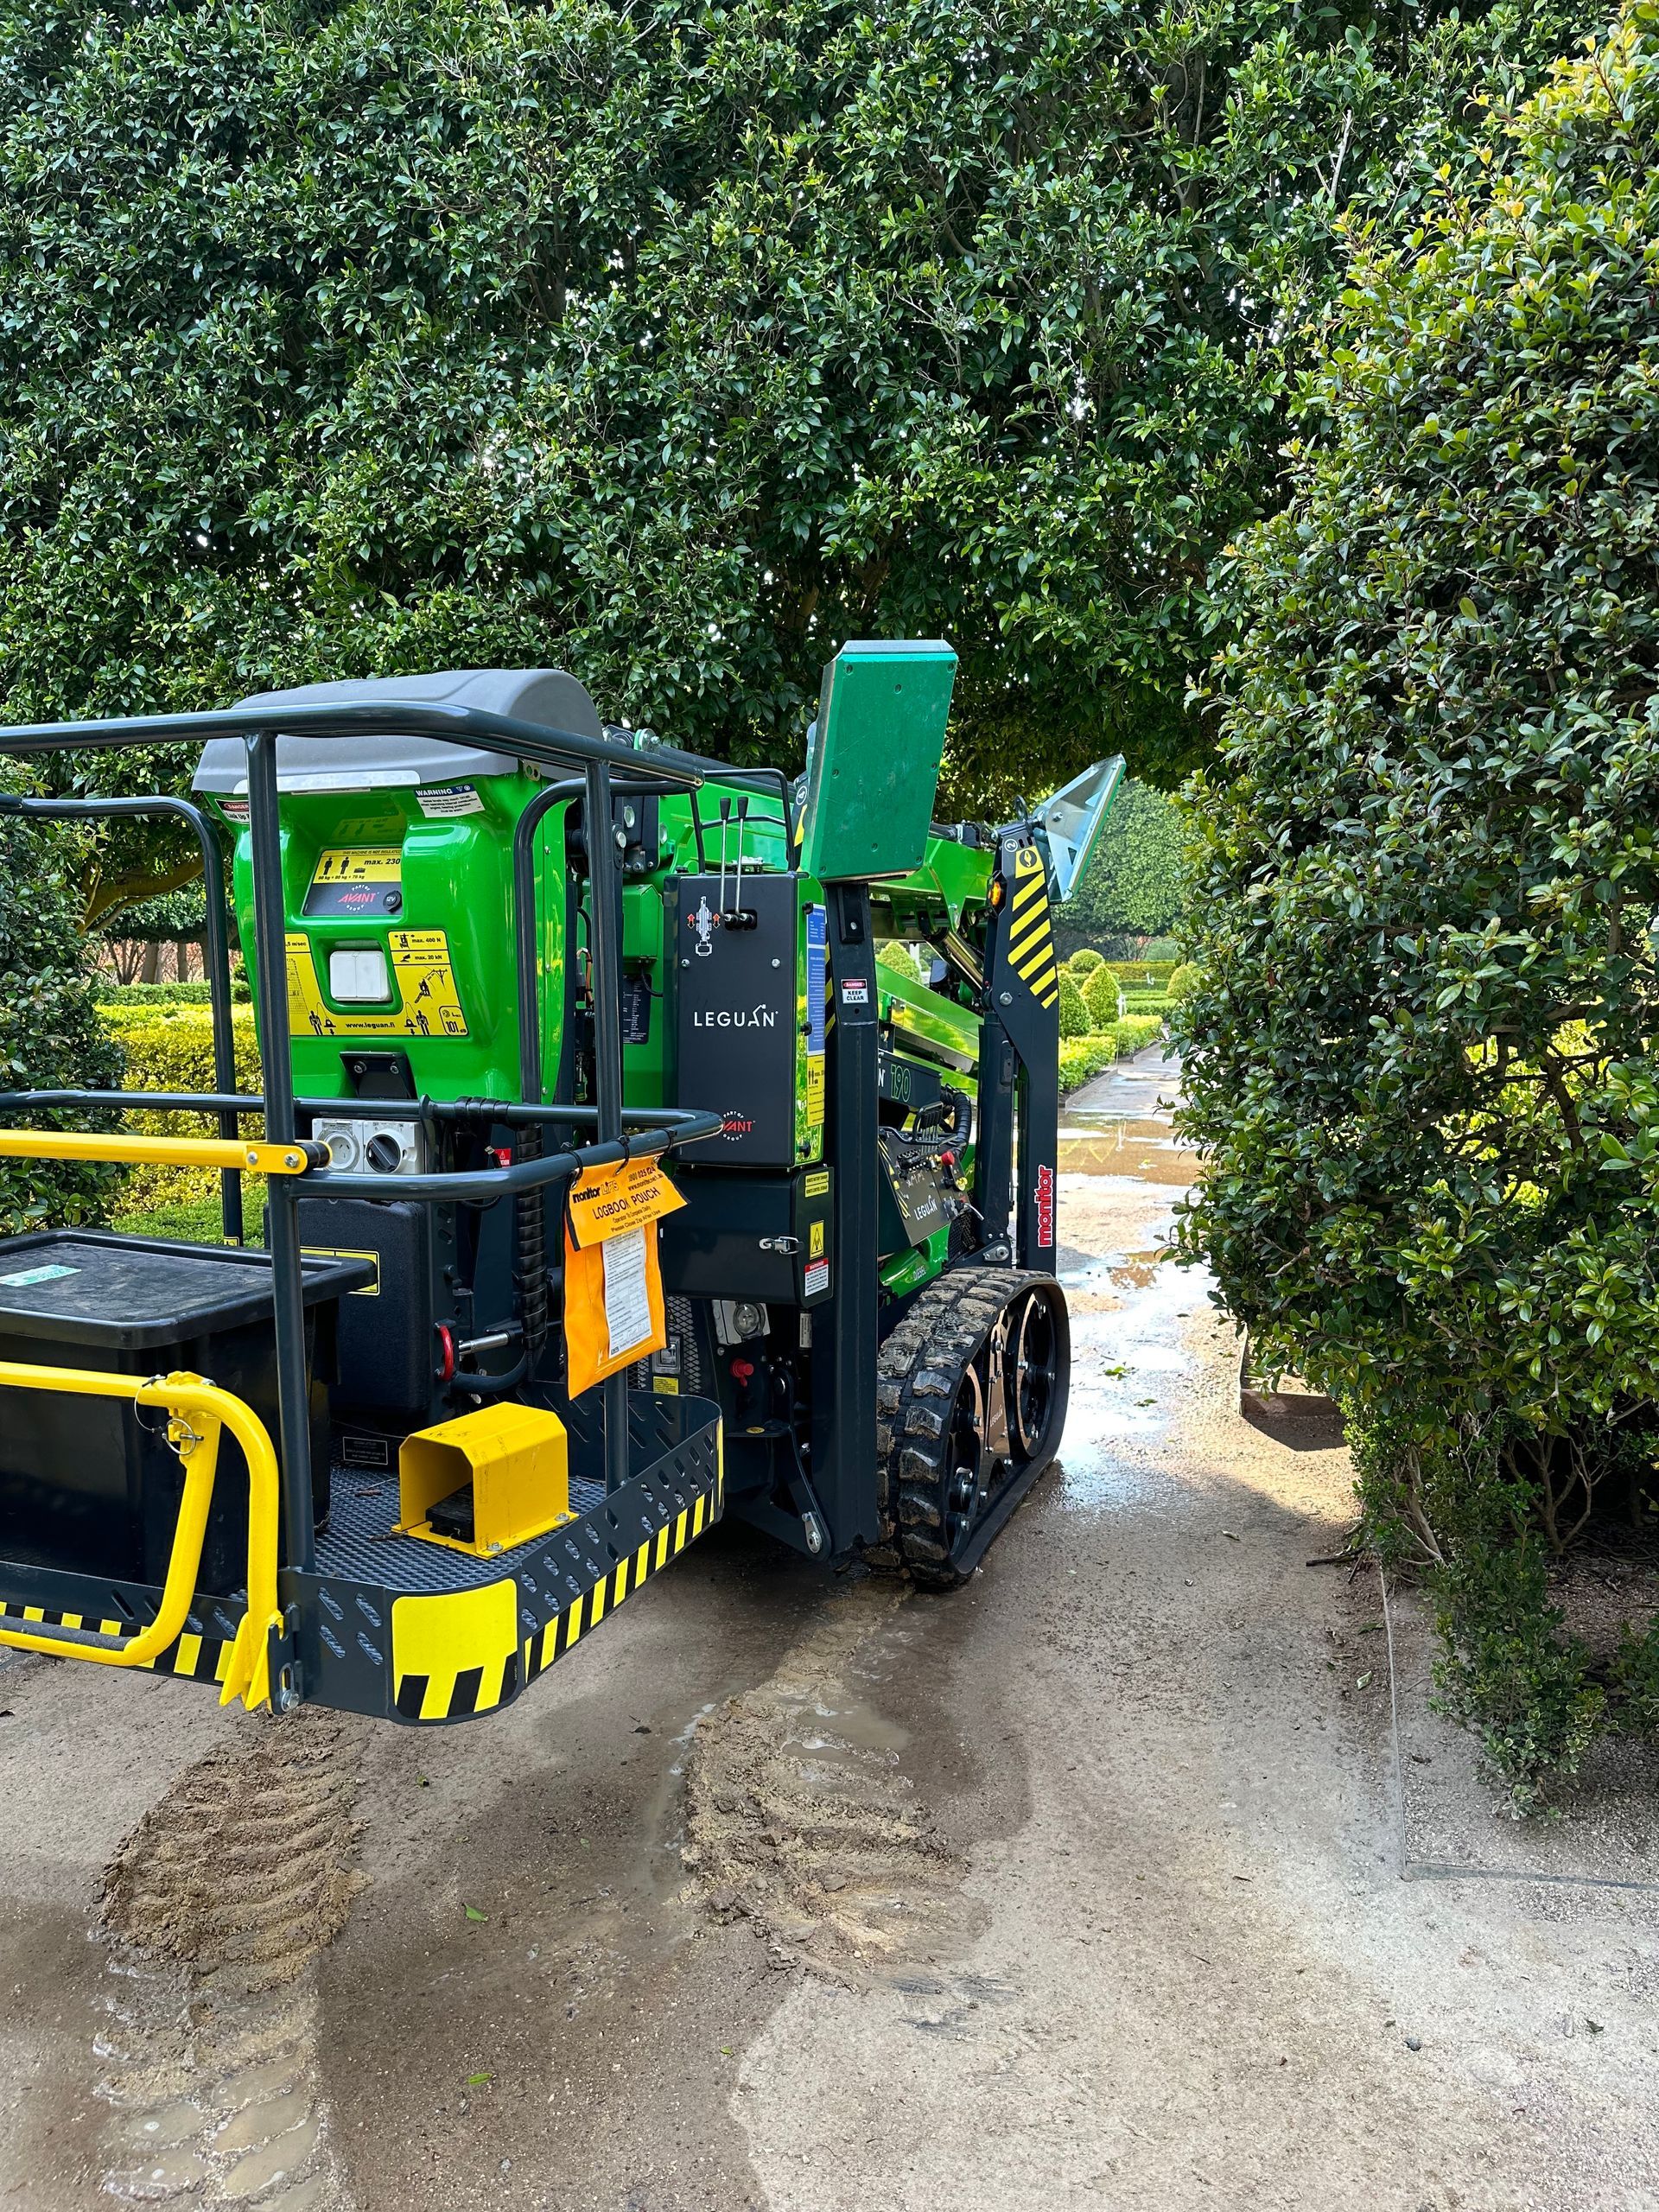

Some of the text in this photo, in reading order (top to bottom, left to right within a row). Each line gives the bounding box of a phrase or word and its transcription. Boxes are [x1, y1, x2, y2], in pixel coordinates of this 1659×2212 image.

[416, 788, 454, 797] WARNING
[337, 893, 377, 903] AVANT
[694, 1004, 774, 1027] LEGUAN
[446, 1021, 460, 1033] 101
[890, 1064, 912, 1103] 190
[722, 1121, 753, 1132] VANT
[572, 1185, 601, 1204] monitor
[592, 1186, 661, 1220] LOGBOOK POUCH
[913, 1195, 938, 1221] LEGUAN
[1034, 1165, 1052, 1246] monitor
